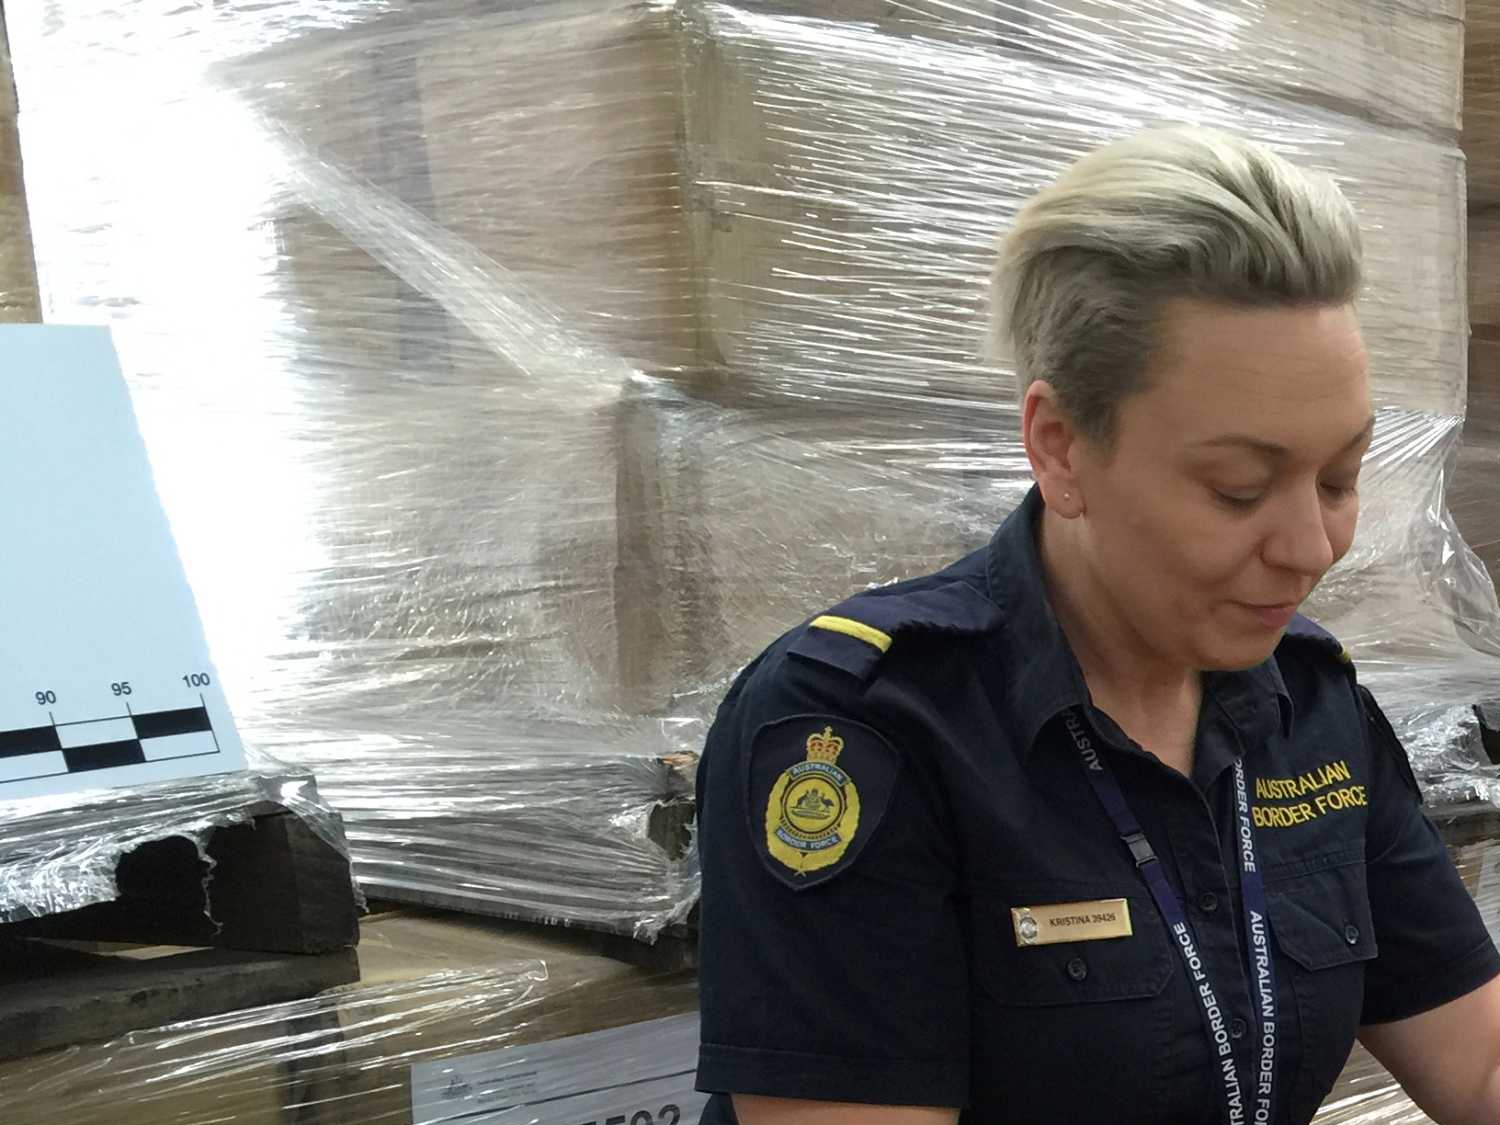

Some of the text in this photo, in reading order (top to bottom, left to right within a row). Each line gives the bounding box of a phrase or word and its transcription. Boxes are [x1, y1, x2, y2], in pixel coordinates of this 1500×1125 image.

[35, 672, 210, 705] 90 95 100
[1251, 786, 1369, 828] BORDER FORCE
[1256, 760, 1352, 798] AUSTRALIAN
[1233, 758, 1256, 873] ORDER FORCE
[1050, 915, 1091, 927] KRISTINA
[1173, 921, 1206, 981] FORCE
[1250, 910, 1274, 1017] AUSTRALIAN
[1199, 982, 1232, 1057] BORDER
[1259, 1021, 1275, 1094] BORDER
